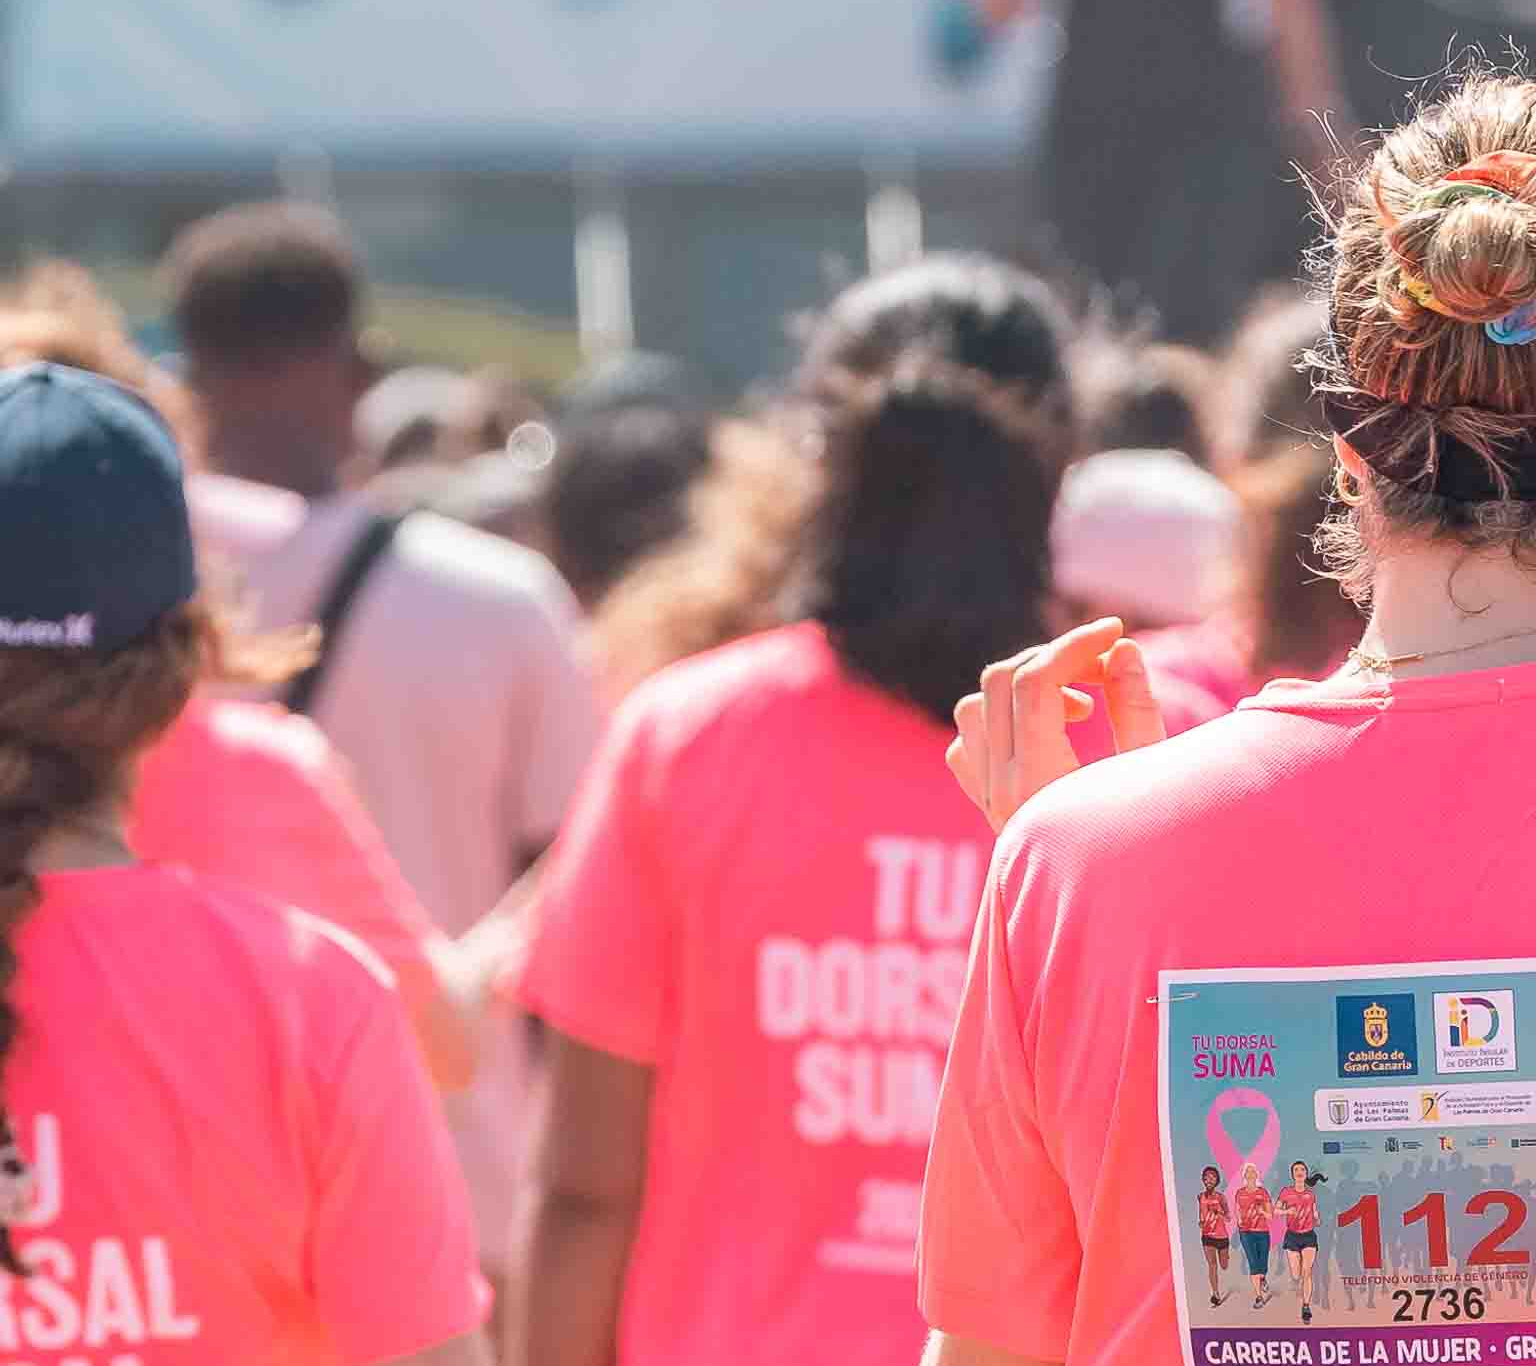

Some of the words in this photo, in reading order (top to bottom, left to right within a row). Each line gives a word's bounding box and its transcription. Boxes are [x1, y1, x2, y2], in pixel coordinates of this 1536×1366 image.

[868, 838, 977, 940] TU
[757, 939, 968, 1045] DORS
[1193, 1035, 1210, 1050] TU
[1216, 1034, 1278, 1050] DORSAL
[1193, 1053, 1276, 1079] SUMA
[1343, 1062, 1369, 1073] Gran
[1371, 1060, 1412, 1072] Canaria
[1348, 1051, 1389, 1062] Cabildo
[1391, 1050, 1405, 1061] de
[1458, 1057, 1505, 1067] DEPORTES
[795, 1041, 937, 1145] SUM
[1337, 1190, 1530, 1269] 112
[1402, 1274, 1462, 1285] VIOLENCIA
[1464, 1273, 1479, 1281] DE
[1392, 1287, 1485, 1323] 2736
[1205, 1340, 1313, 1365] CARRERA
[1320, 1340, 1351, 1365] DE
[1359, 1339, 1389, 1364] LA
[1397, 1337, 1482, 1364] MUJER
